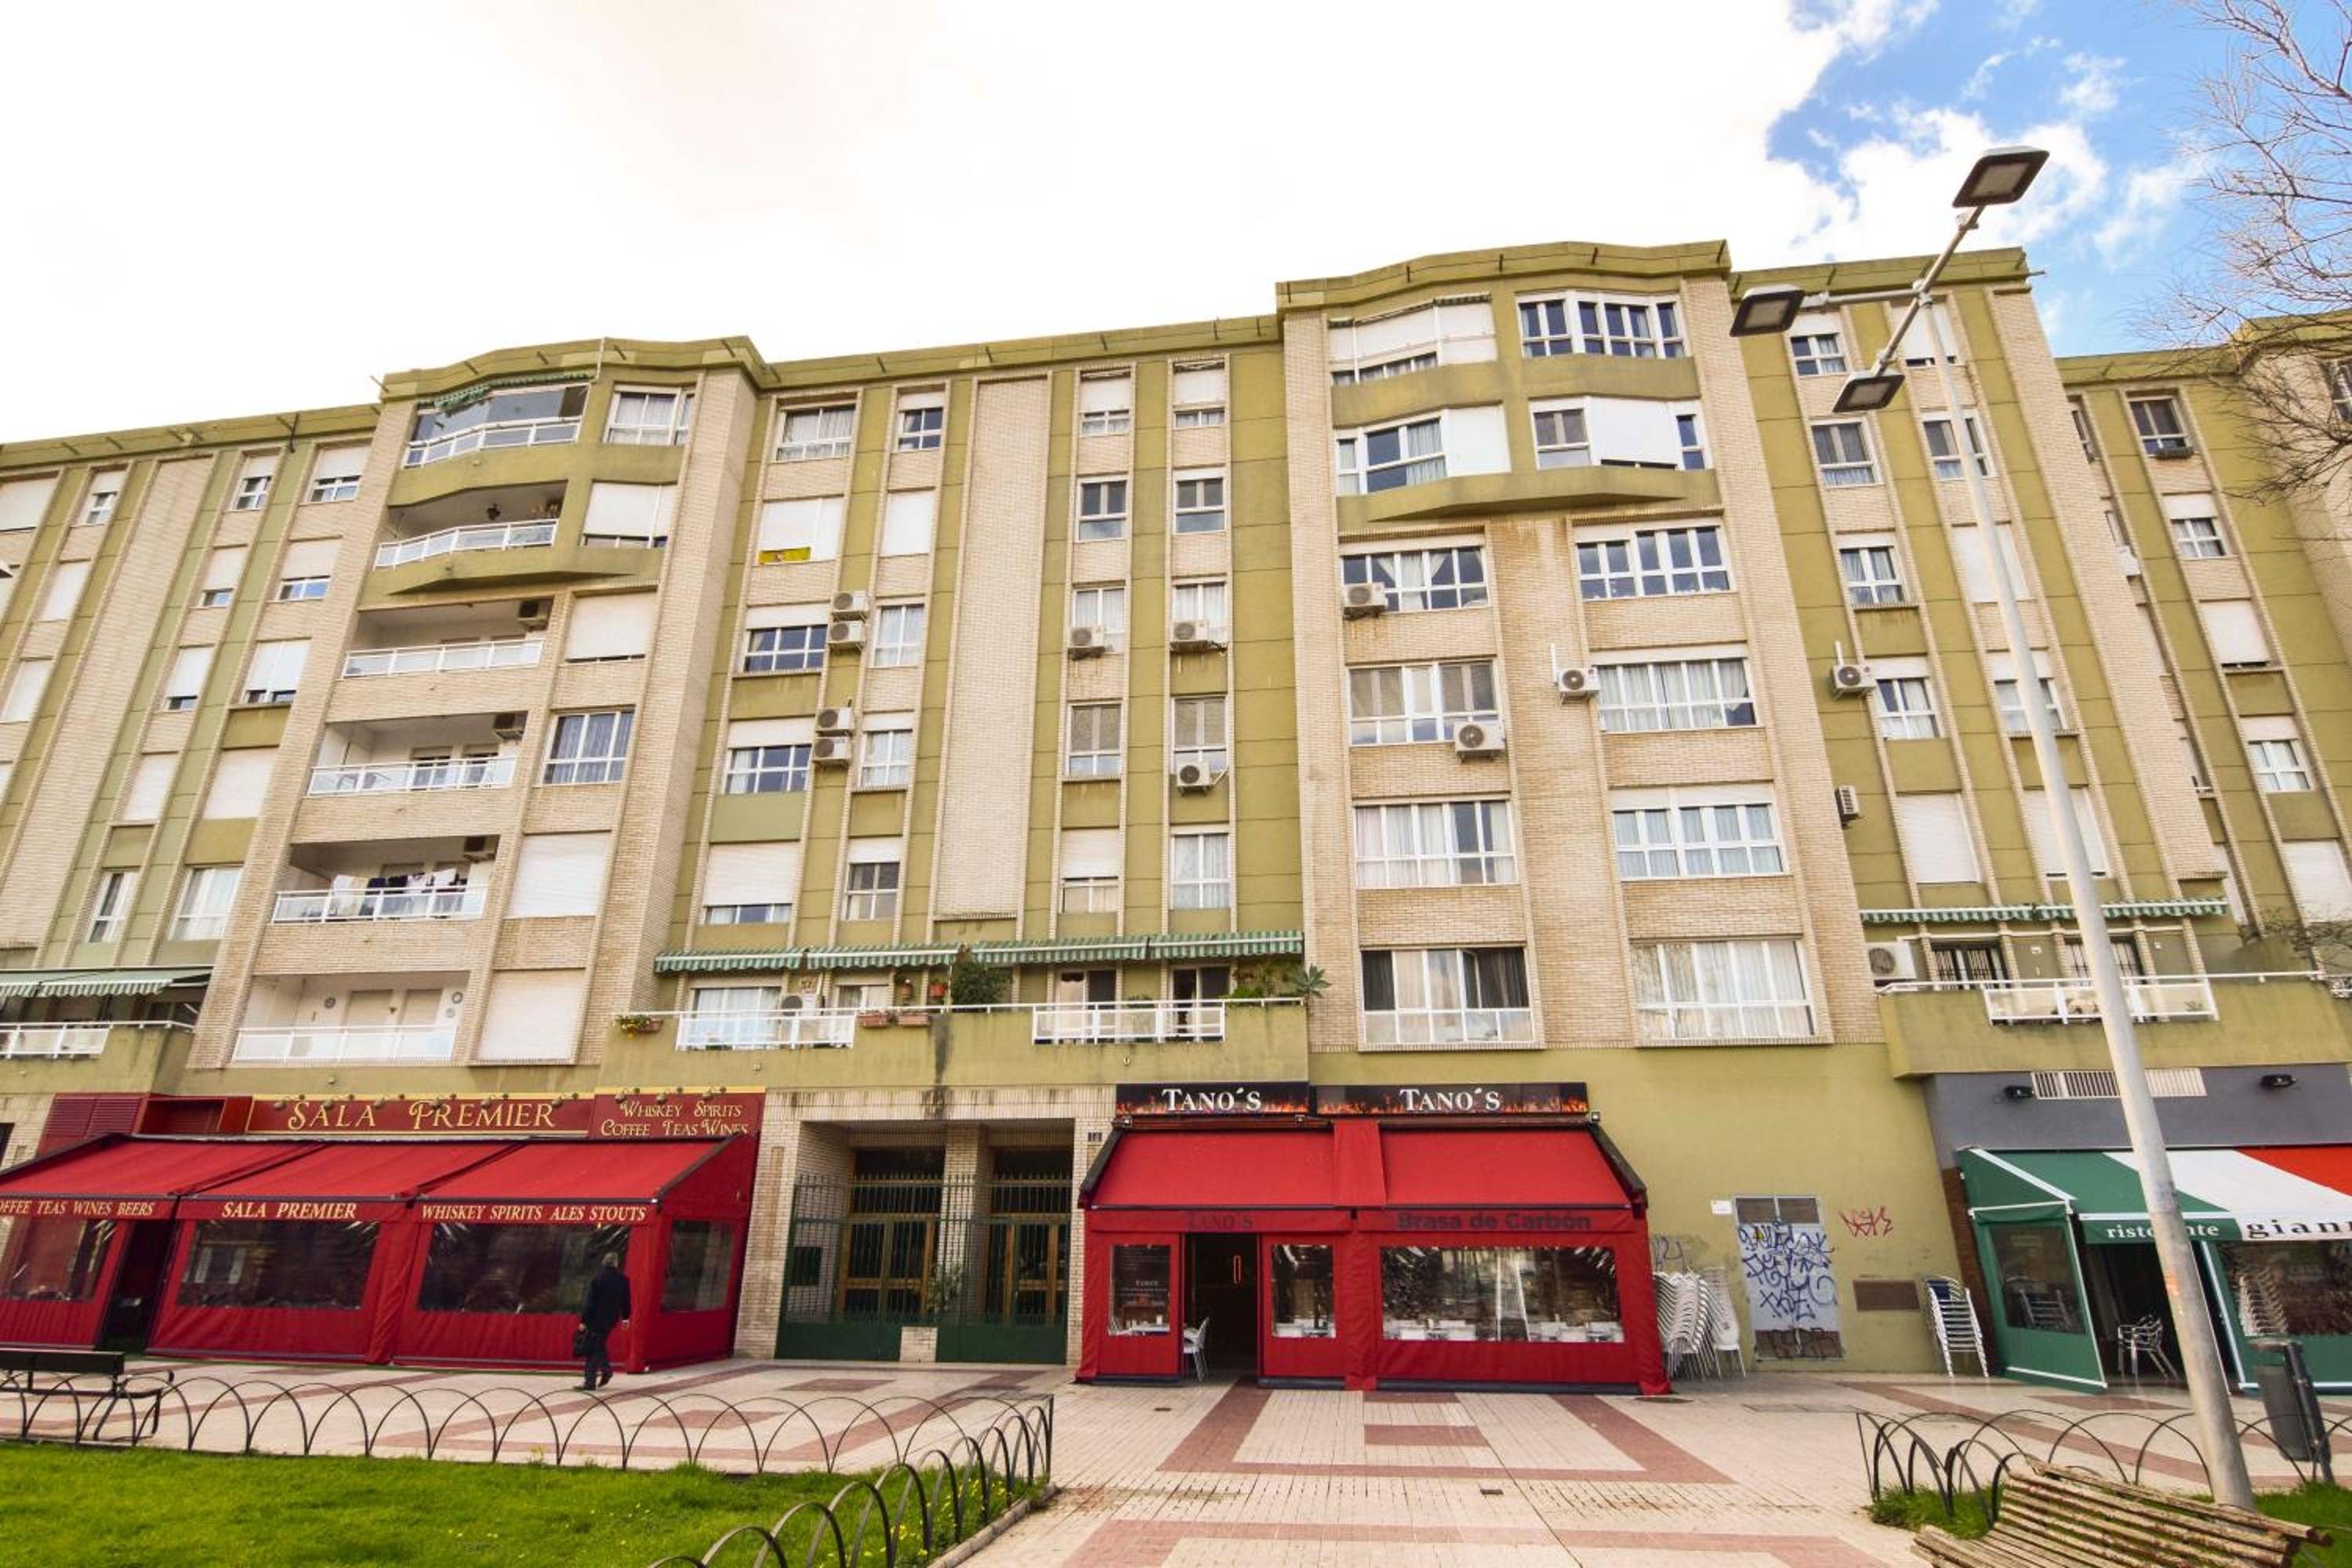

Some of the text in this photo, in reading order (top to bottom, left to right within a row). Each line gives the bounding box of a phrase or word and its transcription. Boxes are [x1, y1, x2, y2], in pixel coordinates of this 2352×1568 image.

[288, 1099, 556, 1130] SALA PREMIER
[620, 1100, 742, 1117] WHISKEY SPIRITS
[601, 1119, 749, 1136] COFFEE TEAS WINES
[37, 1200, 68, 1214] TEAS
[73, 1201, 113, 1215] WINES
[117, 1201, 155, 1215] BEERS
[222, 1201, 357, 1218] SALA PREMIER
[422, 1205, 647, 1221] WHISKEY SPIRITS ALES STOUTS
